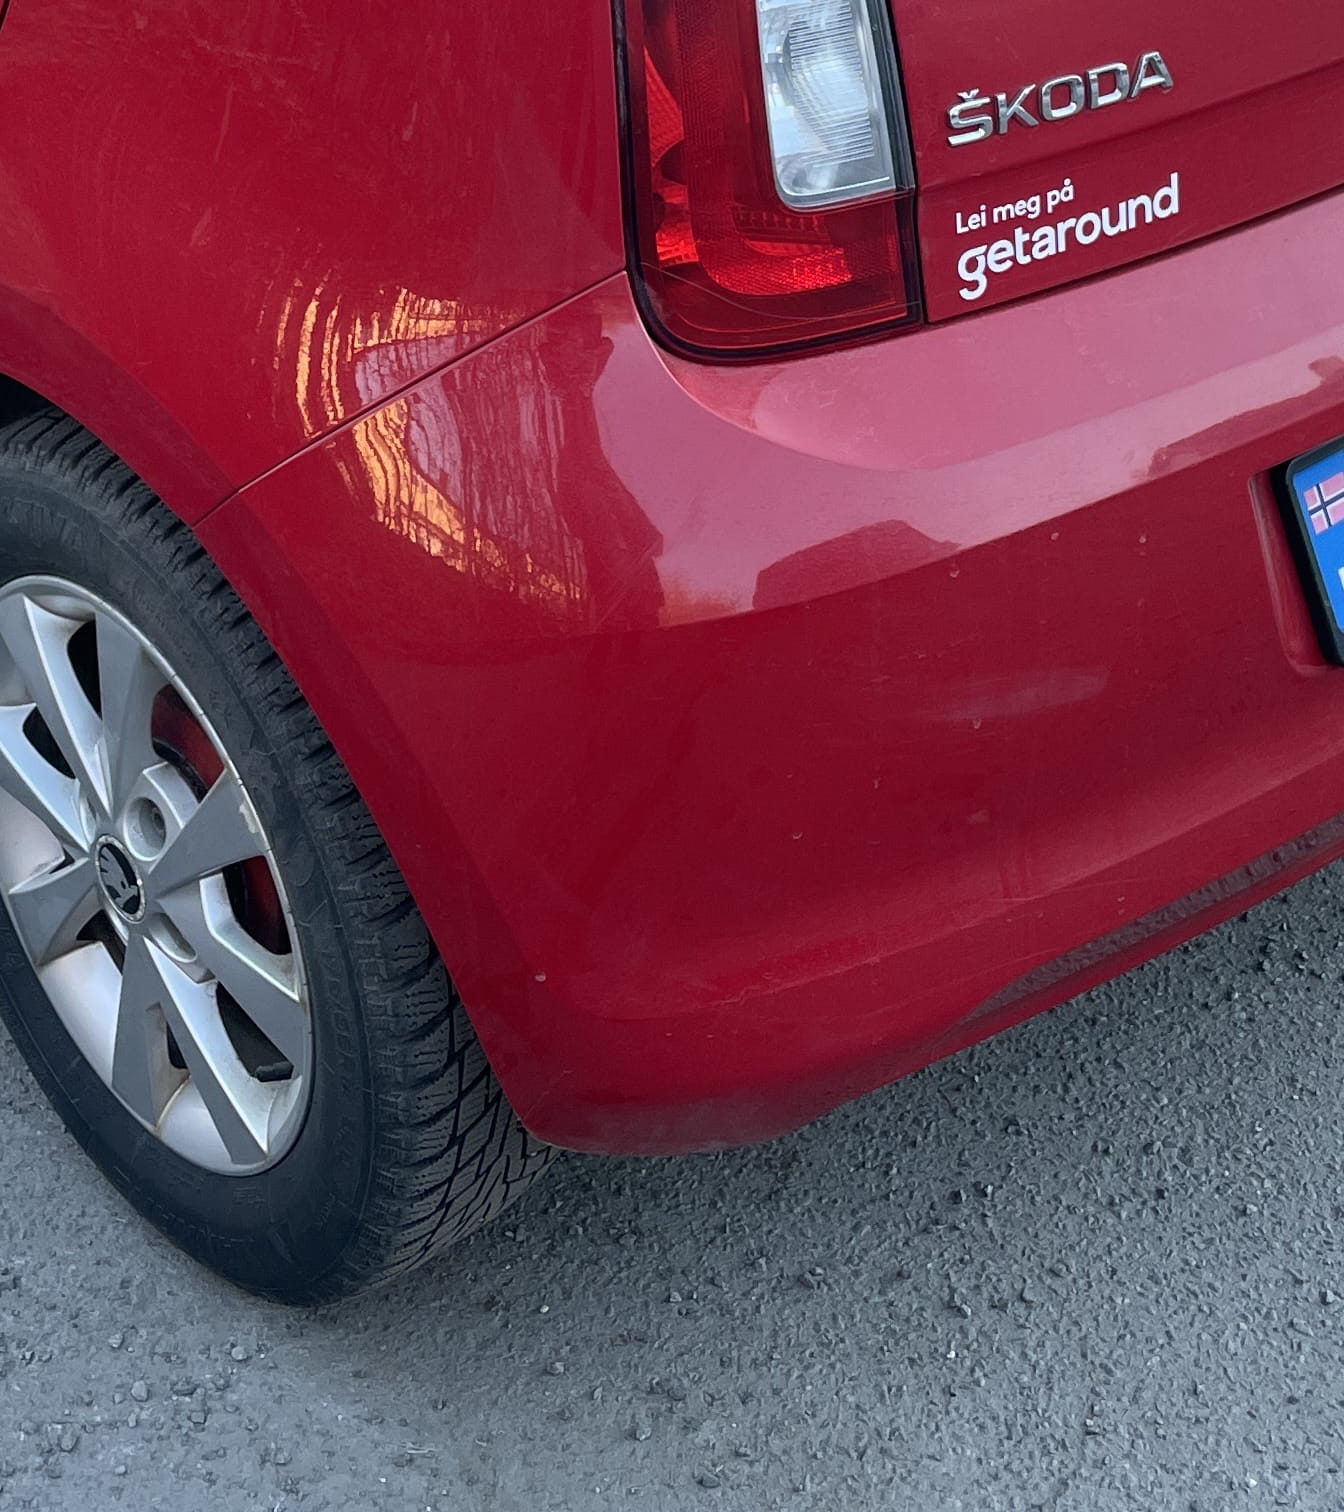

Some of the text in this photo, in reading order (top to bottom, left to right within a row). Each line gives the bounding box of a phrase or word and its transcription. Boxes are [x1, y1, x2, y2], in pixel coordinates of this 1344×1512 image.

[947, 50, 1175, 147] ŠKODA
[955, 178, 1074, 235] Lei meg på
[957, 171, 1180, 301] getaround
